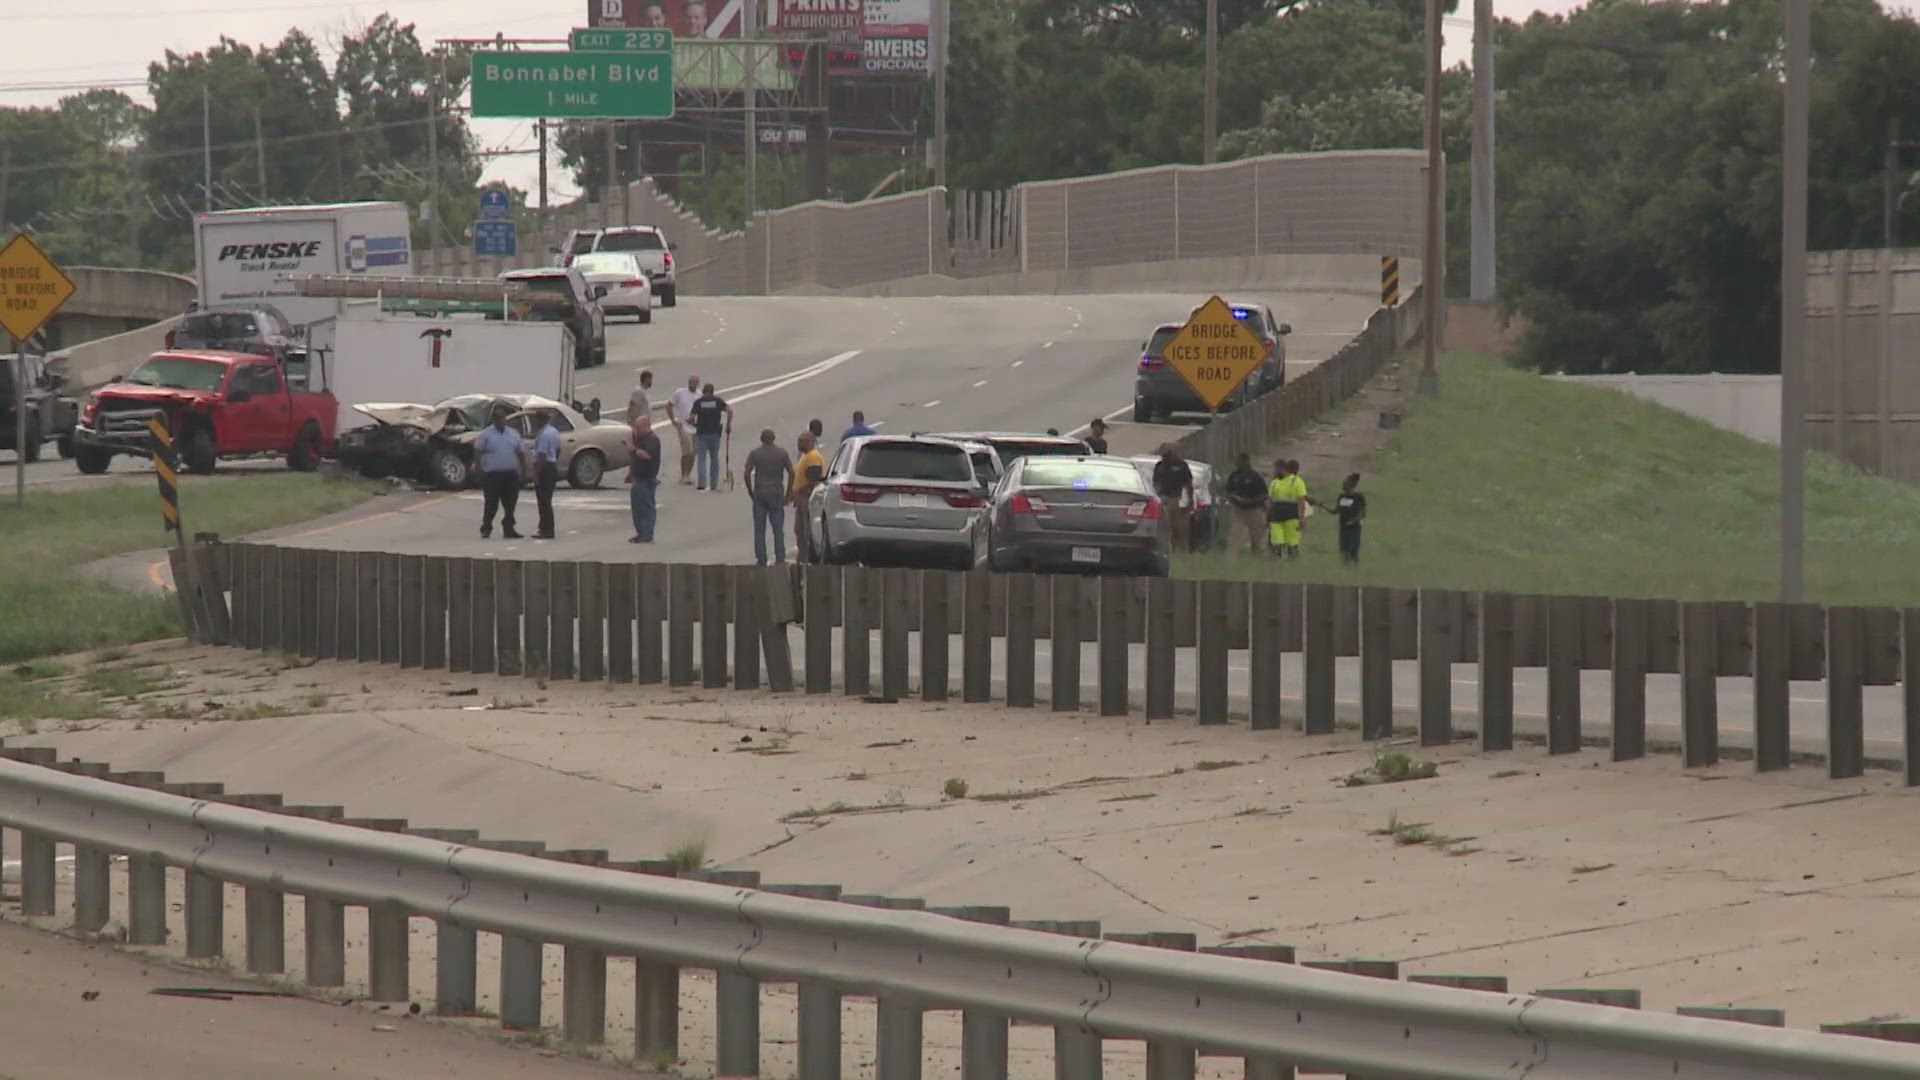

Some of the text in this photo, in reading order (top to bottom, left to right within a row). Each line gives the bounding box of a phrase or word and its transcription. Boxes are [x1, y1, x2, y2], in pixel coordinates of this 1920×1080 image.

[784, 14, 861, 28] EMBROIDERY
[581, 33, 665, 48] EXIT 229
[486, 63, 660, 82] Bonnabel Blvd
[547, 91, 598, 106] 1 MILE
[218, 240, 321, 262] PENSKE
[0, 266, 41, 280] BRIDGE
[16, 283, 57, 296] BEFORE
[6, 298, 37, 311] ROAD
[1191, 324, 1239, 339] BRIDGE
[1172, 346, 1257, 360] ICES BEFORE
[1197, 367, 1232, 381] ROAD
